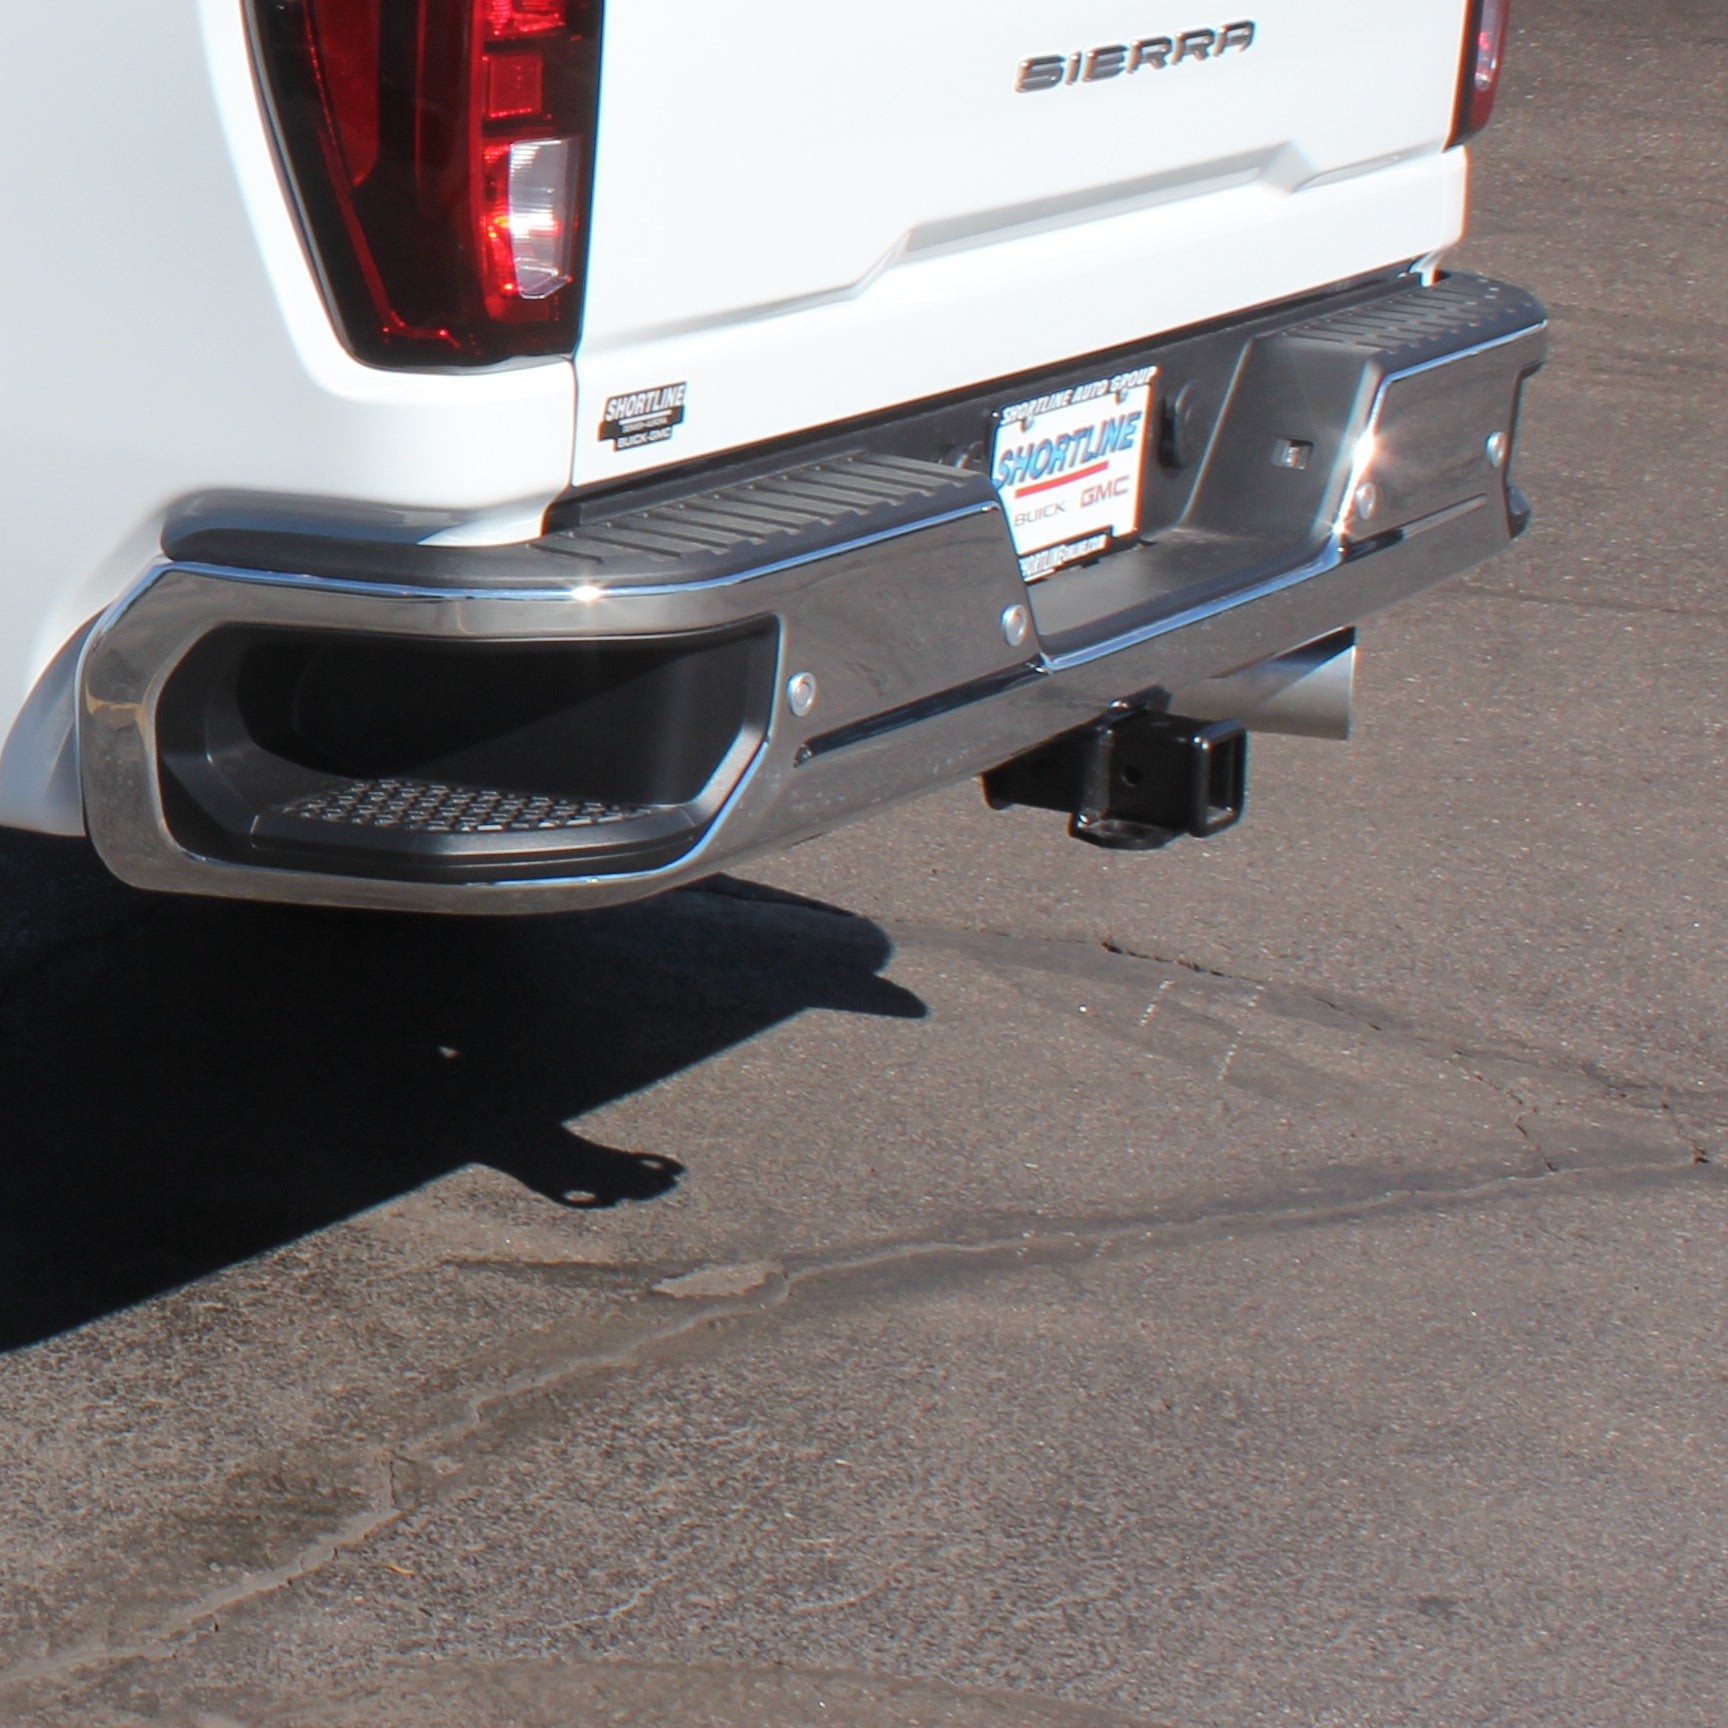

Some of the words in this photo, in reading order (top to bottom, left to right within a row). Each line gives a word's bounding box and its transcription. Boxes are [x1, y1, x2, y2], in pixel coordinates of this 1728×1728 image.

[1015, 20, 1255, 93] SIERRA
[605, 384, 687, 422] SHORTLINE
[993, 411, 1143, 490] SHORTLINE
[1014, 500, 1067, 527] BUICK
[1079, 475, 1130, 508] GMC
